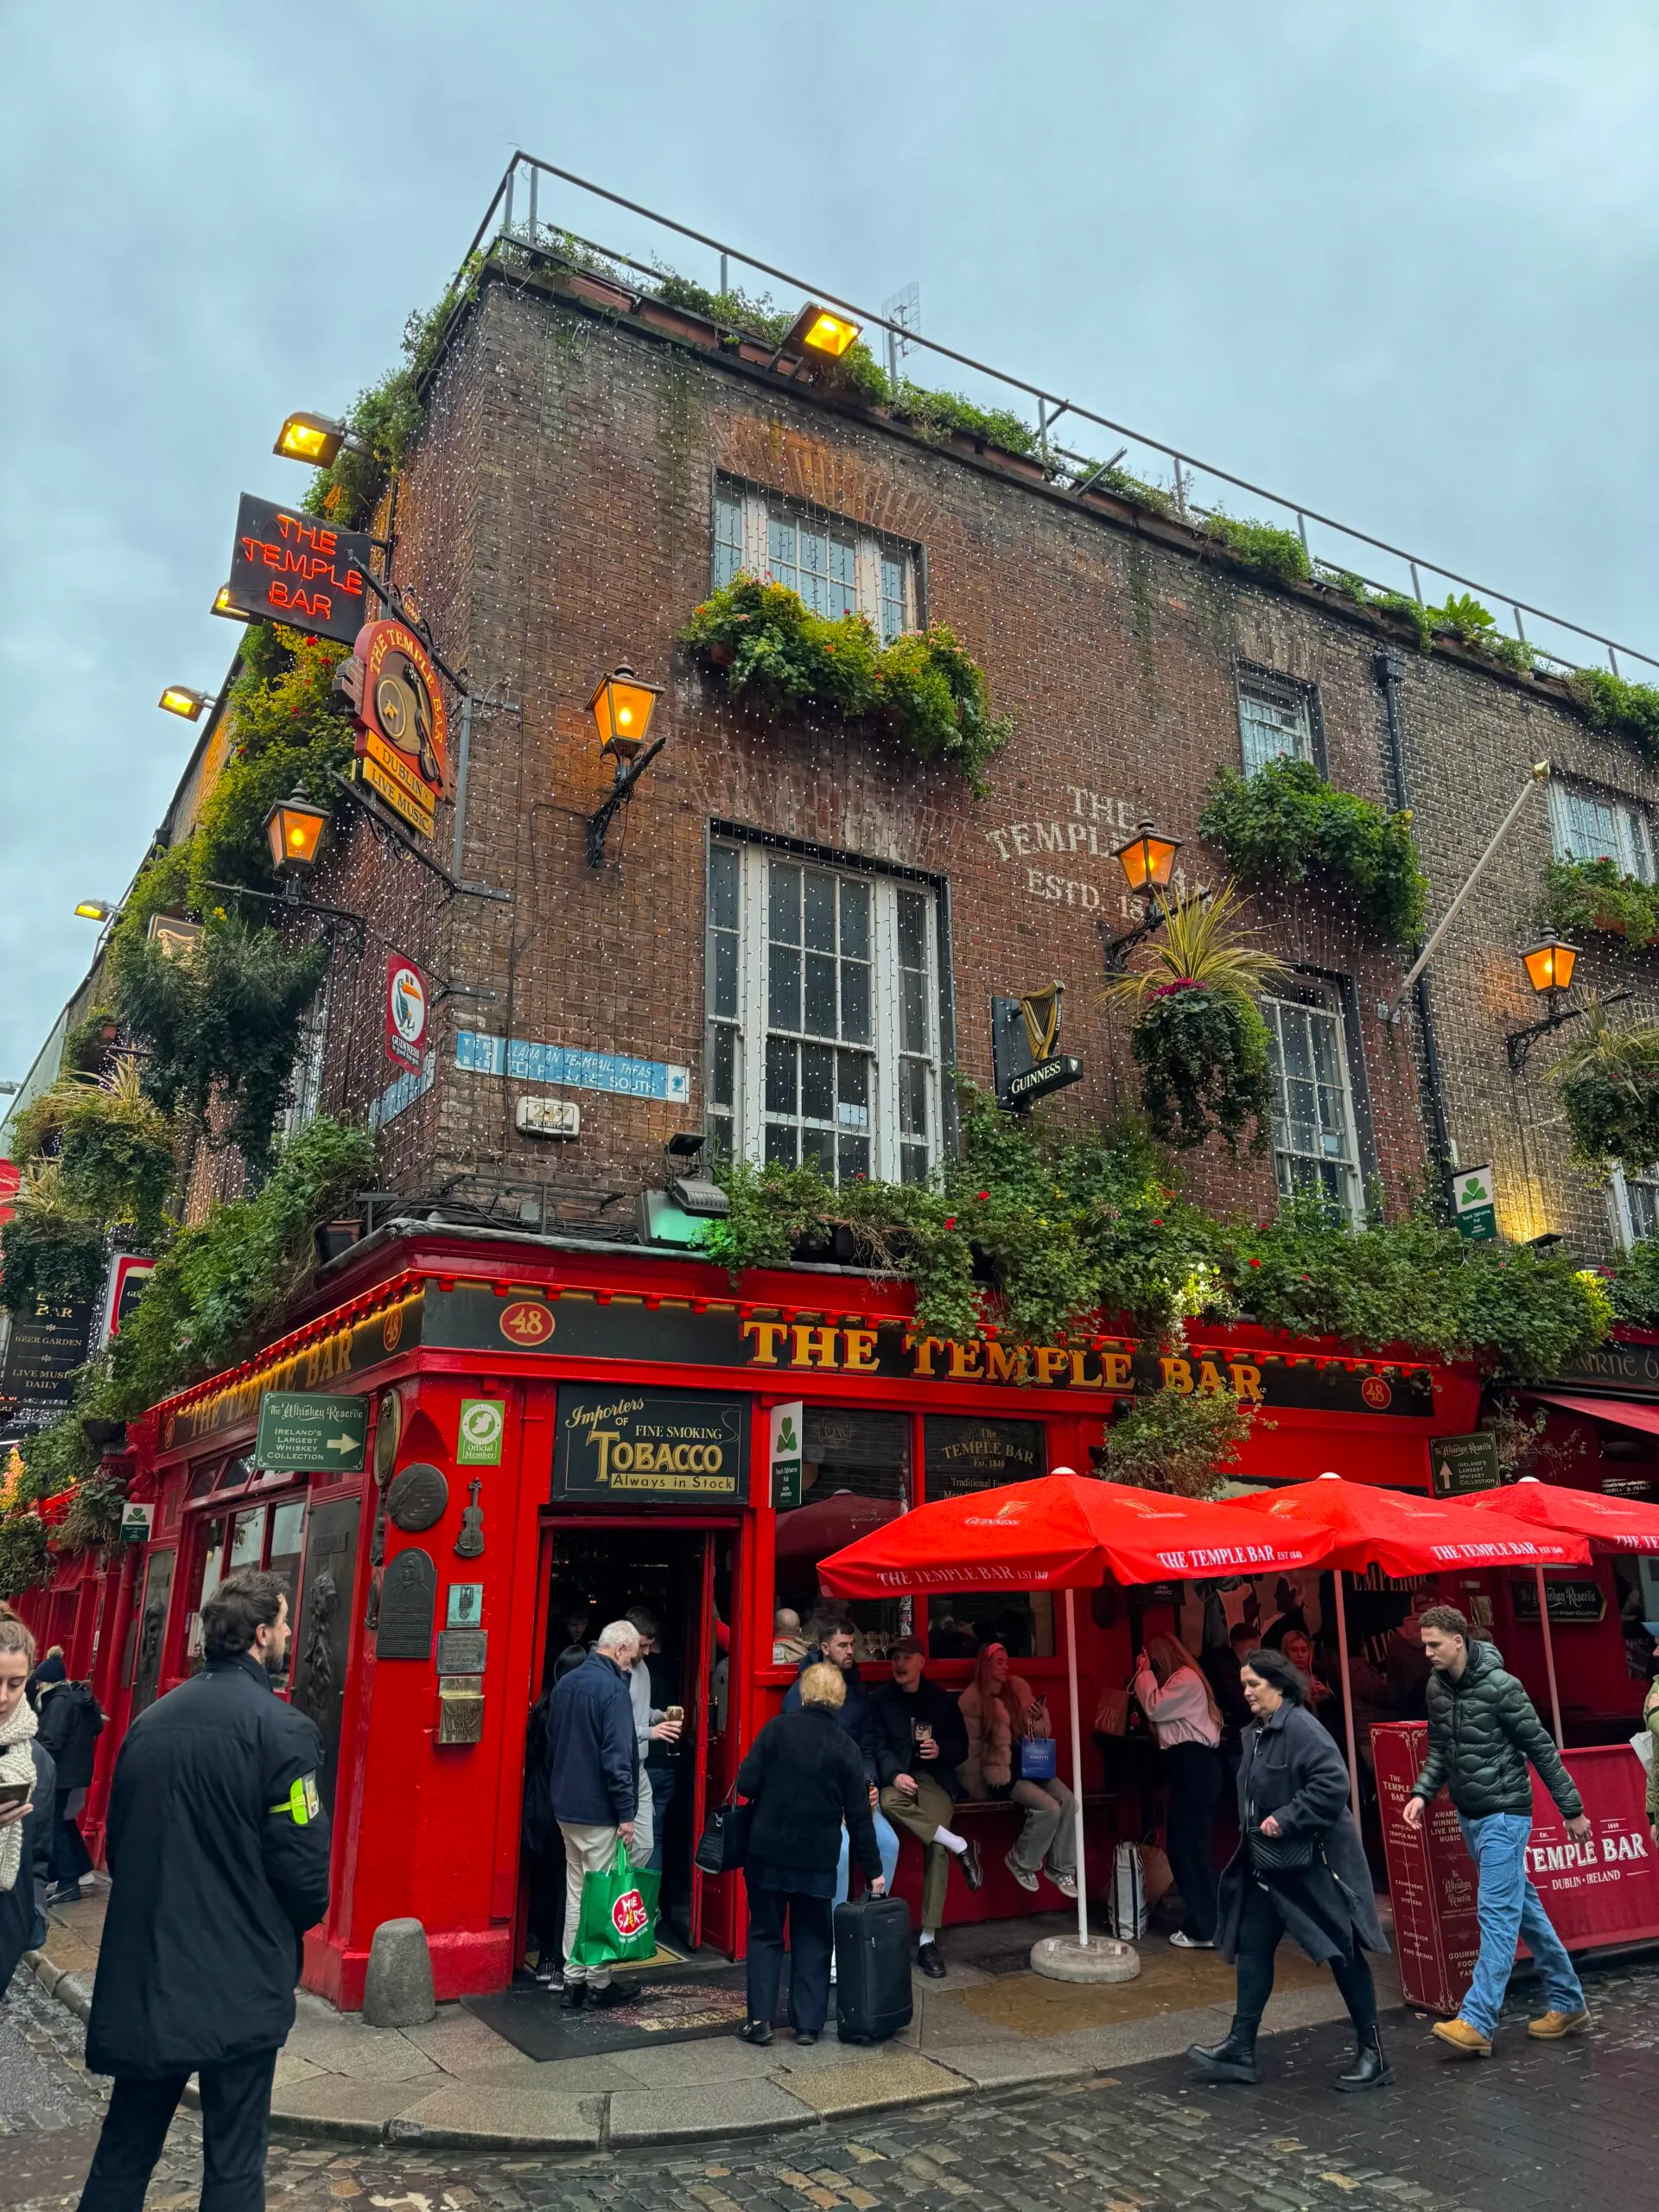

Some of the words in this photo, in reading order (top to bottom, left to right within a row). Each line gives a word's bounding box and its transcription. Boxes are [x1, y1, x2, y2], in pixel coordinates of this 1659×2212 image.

[276, 513, 338, 556] THE
[242, 537, 363, 596] TEMPLE
[269, 581, 331, 621] BAR
[369, 633, 388, 677] THE
[385, 628, 435, 690] TEMPLE
[431, 696, 444, 745] BAR
[381, 748, 424, 798] DUBLIN
[371, 766, 396, 801] LIVE
[397, 795, 430, 832] MUSIC
[1066, 784, 1136, 831] THE
[391, 1034, 420, 1059] GUINNESS
[671, 1076, 684, 1093] 2
[1011, 1060, 1062, 1095] GUINNESS
[609, 1077, 658, 1094] SOUTH
[508, 1306, 543, 1336] 48
[15, 1335, 41, 1344] BEER
[41, 1337, 83, 1347] GARDEN
[304, 1332, 353, 1388] BAR
[740, 1321, 880, 1374] THE
[902, 1332, 1135, 1393] TEMPLE
[1160, 1357, 1266, 1402] BAR
[1365, 1382, 1385, 1402] 48
[12, 1368, 38, 1377] LIVE
[40, 1370, 73, 1380] MUSI
[25, 1380, 60, 1390] DAILY
[269, 1404, 282, 1415] The
[281, 1401, 325, 1421] Whiskey
[327, 1404, 364, 1423] Reserve
[565, 1397, 645, 1429] Importers
[614, 1417, 629, 1427] OF
[275, 1428, 322, 1437] IRELAND'S
[635, 1425, 664, 1438] FINE
[666, 1427, 723, 1440] SMOKING
[981, 1427, 997, 1439] The
[276, 1444, 318, 1452] WHISKEY
[277, 1436, 318, 1445] LARGEST
[267, 1452, 325, 1461] COLLECTION
[585, 1430, 723, 1483] TOBACCO
[941, 1440, 1002, 1460] TEMPLE
[1005, 1444, 1034, 1465] BAR
[1440, 1443, 1469, 1458] Whiskey
[1468, 1441, 1492, 1455] Reserve
[974, 1459, 988, 1467] Est.
[988, 1459, 1006, 1468] 1840
[613, 1474, 666, 1488] Always
[673, 1477, 687, 1487] in
[691, 1476, 733, 1490] Stock
[950, 1477, 991, 1487] Traditional
[965, 1516, 1020, 1527] GUINNESS
[1614, 1535, 1643, 1548] THE
[1156, 1551, 1189, 1568] THE
[1187, 1548, 1249, 1567] TEMPLE
[1246, 1544, 1276, 1563] BAR
[1277, 1551, 1288, 1560] EST
[1290, 1550, 1303, 1560] 1840
[1430, 1546, 1462, 1560] THE
[1457, 1541, 1512, 1558] TEMPLE
[1510, 1541, 1539, 1555] BAR
[877, 1571, 912, 1586] THE
[912, 1567, 979, 1584] TEMPLE
[977, 1565, 1014, 1580] BAR
[1017, 1570, 1033, 1580] EST
[1033, 1570, 1049, 1580] 1840
[1566, 1586, 1597, 1607] Reserve
[1389, 1774, 1402, 1783] THE
[1382, 1781, 1411, 1793] TEMPLE
[1390, 1792, 1406, 1802] BAR
[1392, 1823, 1413, 1832] OFFICIAL
[1432, 1818, 1459, 1827] WINNIN
[1389, 1830, 1407, 1839] TEMPLE
[1439, 1834, 1461, 1843] MUSIC
[1389, 1839, 1419, 1849] MERCHANDISE
[1523, 1841, 1599, 1873] TEMPLE
[1601, 1833, 1649, 1862] BAR
[1395, 1879, 1425, 1891] CHAMPAGNE
[1442, 1878, 1472, 1895] Whiskey
[1552, 1875, 1582, 1891] DUBLIN
[1586, 1870, 1621, 1885] IRELAND
[1401, 1896, 1422, 1907] OYSTERS
[1447, 1894, 1471, 1907] Reserve
[1403, 1948, 1415, 1956] FINE
[1415, 1951, 1434, 1961] DRINKS
[1448, 1949, 1480, 1960] GOURME
